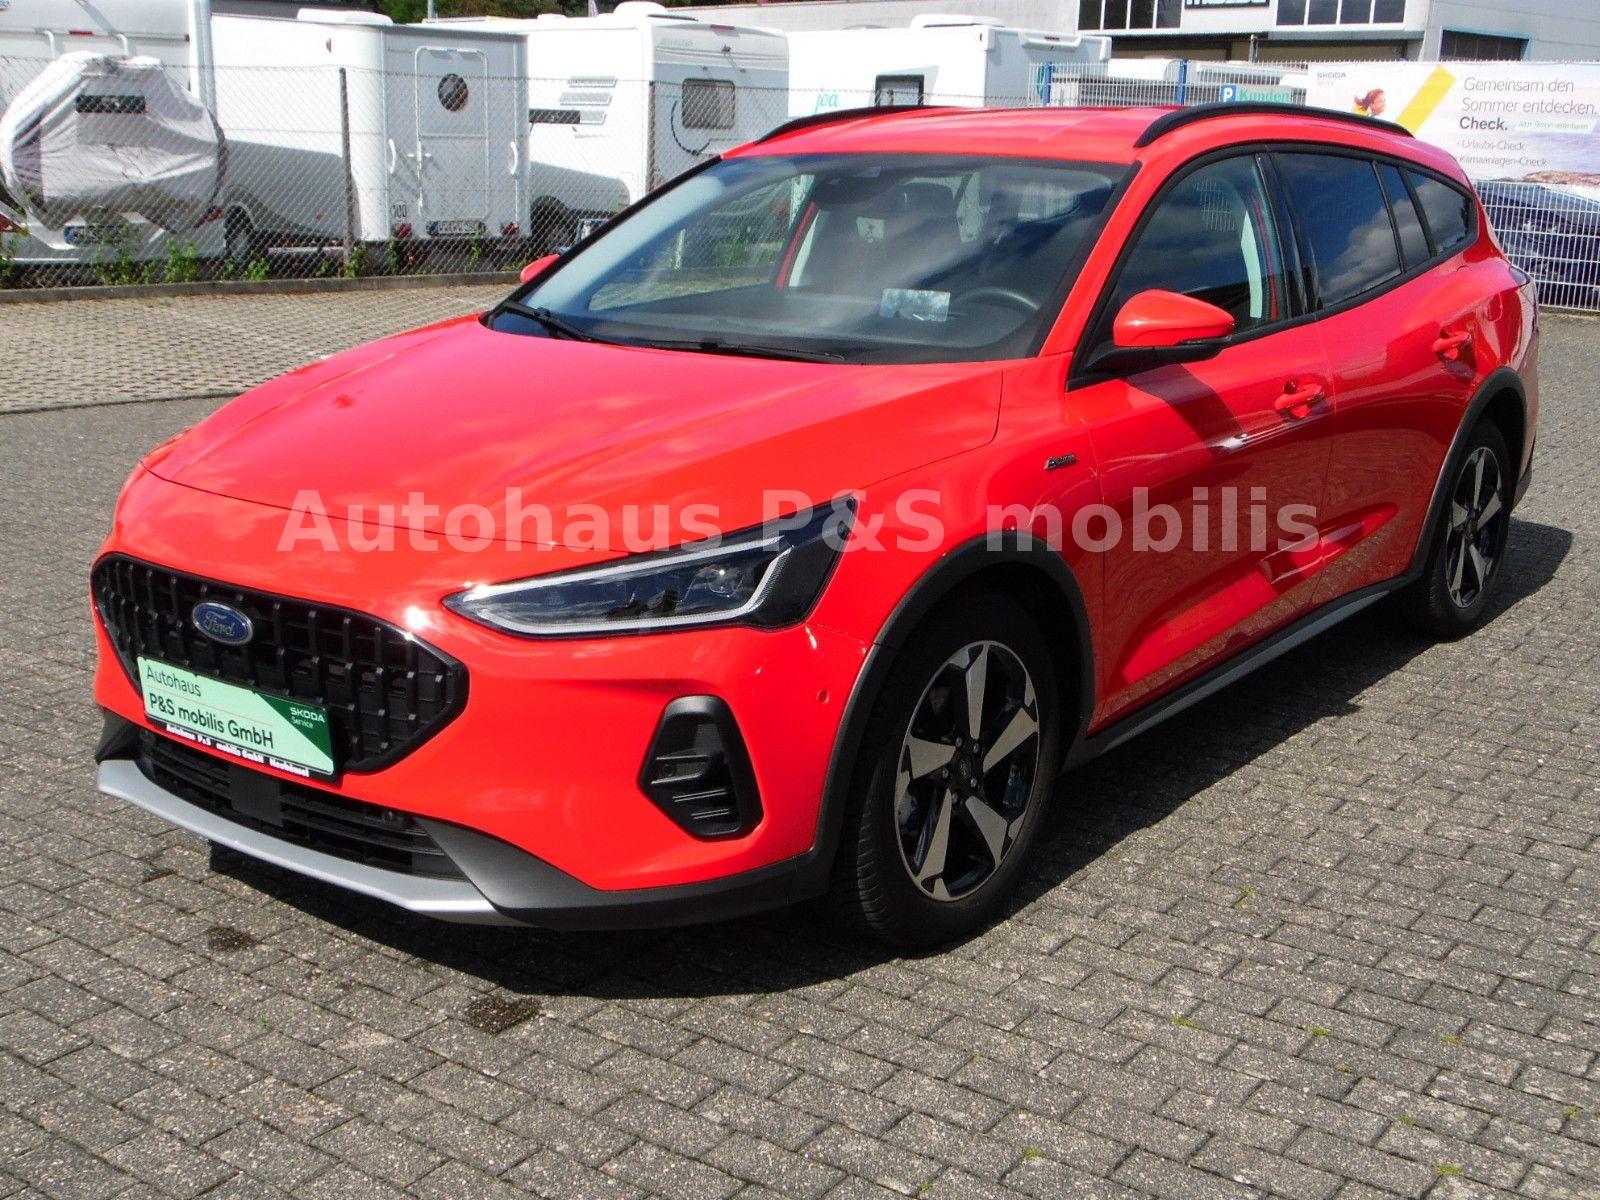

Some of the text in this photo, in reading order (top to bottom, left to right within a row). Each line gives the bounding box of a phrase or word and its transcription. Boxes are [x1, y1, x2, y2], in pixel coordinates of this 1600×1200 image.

[1464, 77, 1574, 92] Gemeinsam den
[1462, 97, 1597, 115] Sommer entdecken.
[1459, 116, 1508, 131] Check.
[203, 610, 236, 637] Ford
[146, 665, 202, 697] Autohaus
[149, 692, 274, 750] P&S mobilis GmbH
